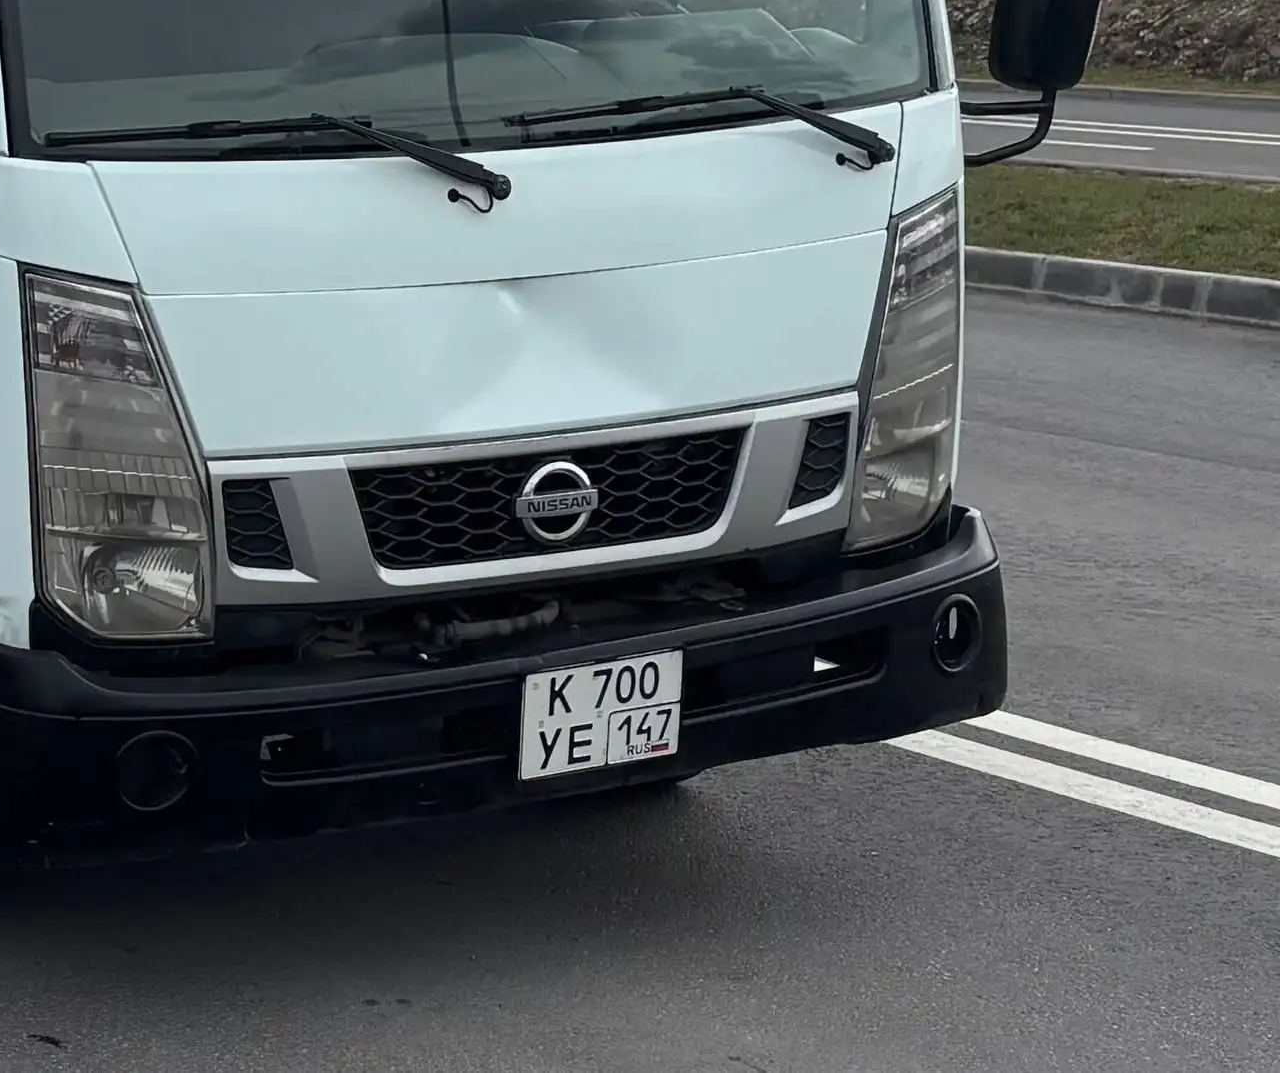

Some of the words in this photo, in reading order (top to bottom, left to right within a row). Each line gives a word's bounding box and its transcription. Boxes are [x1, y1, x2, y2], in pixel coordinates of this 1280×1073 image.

[527, 495, 592, 513] NISSAN
[593, 661, 660, 709] 700
[617, 708, 672, 745] 147
[627, 742, 651, 756] RUS
